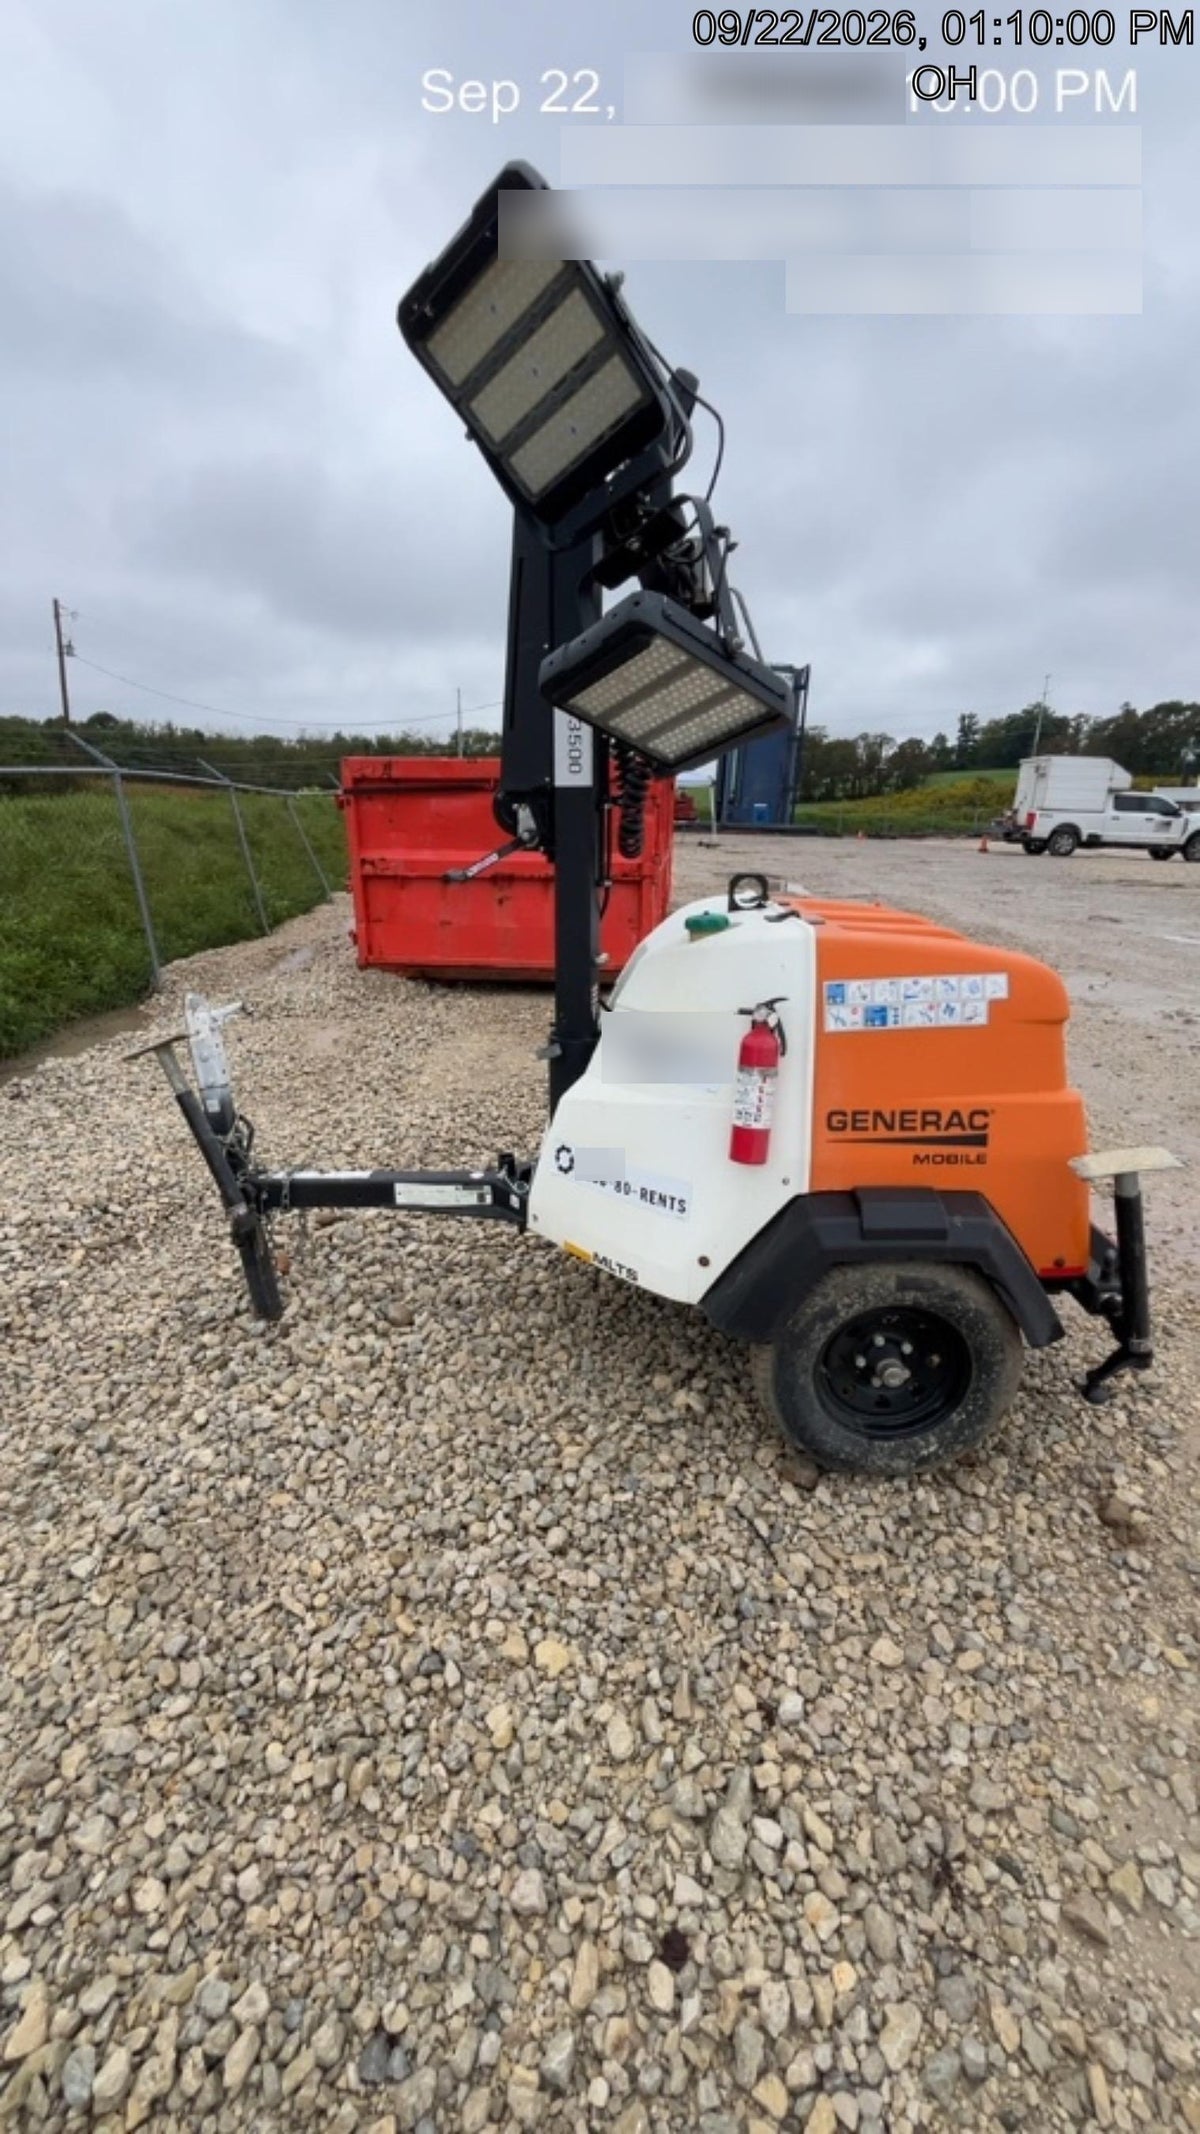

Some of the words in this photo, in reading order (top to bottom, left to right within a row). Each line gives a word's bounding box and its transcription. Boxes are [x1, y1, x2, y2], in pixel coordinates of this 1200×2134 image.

[568, 718, 582, 774] 3500
[826, 1109, 990, 1132] GENERAC
[912, 1153, 988, 1165] MOBILE
